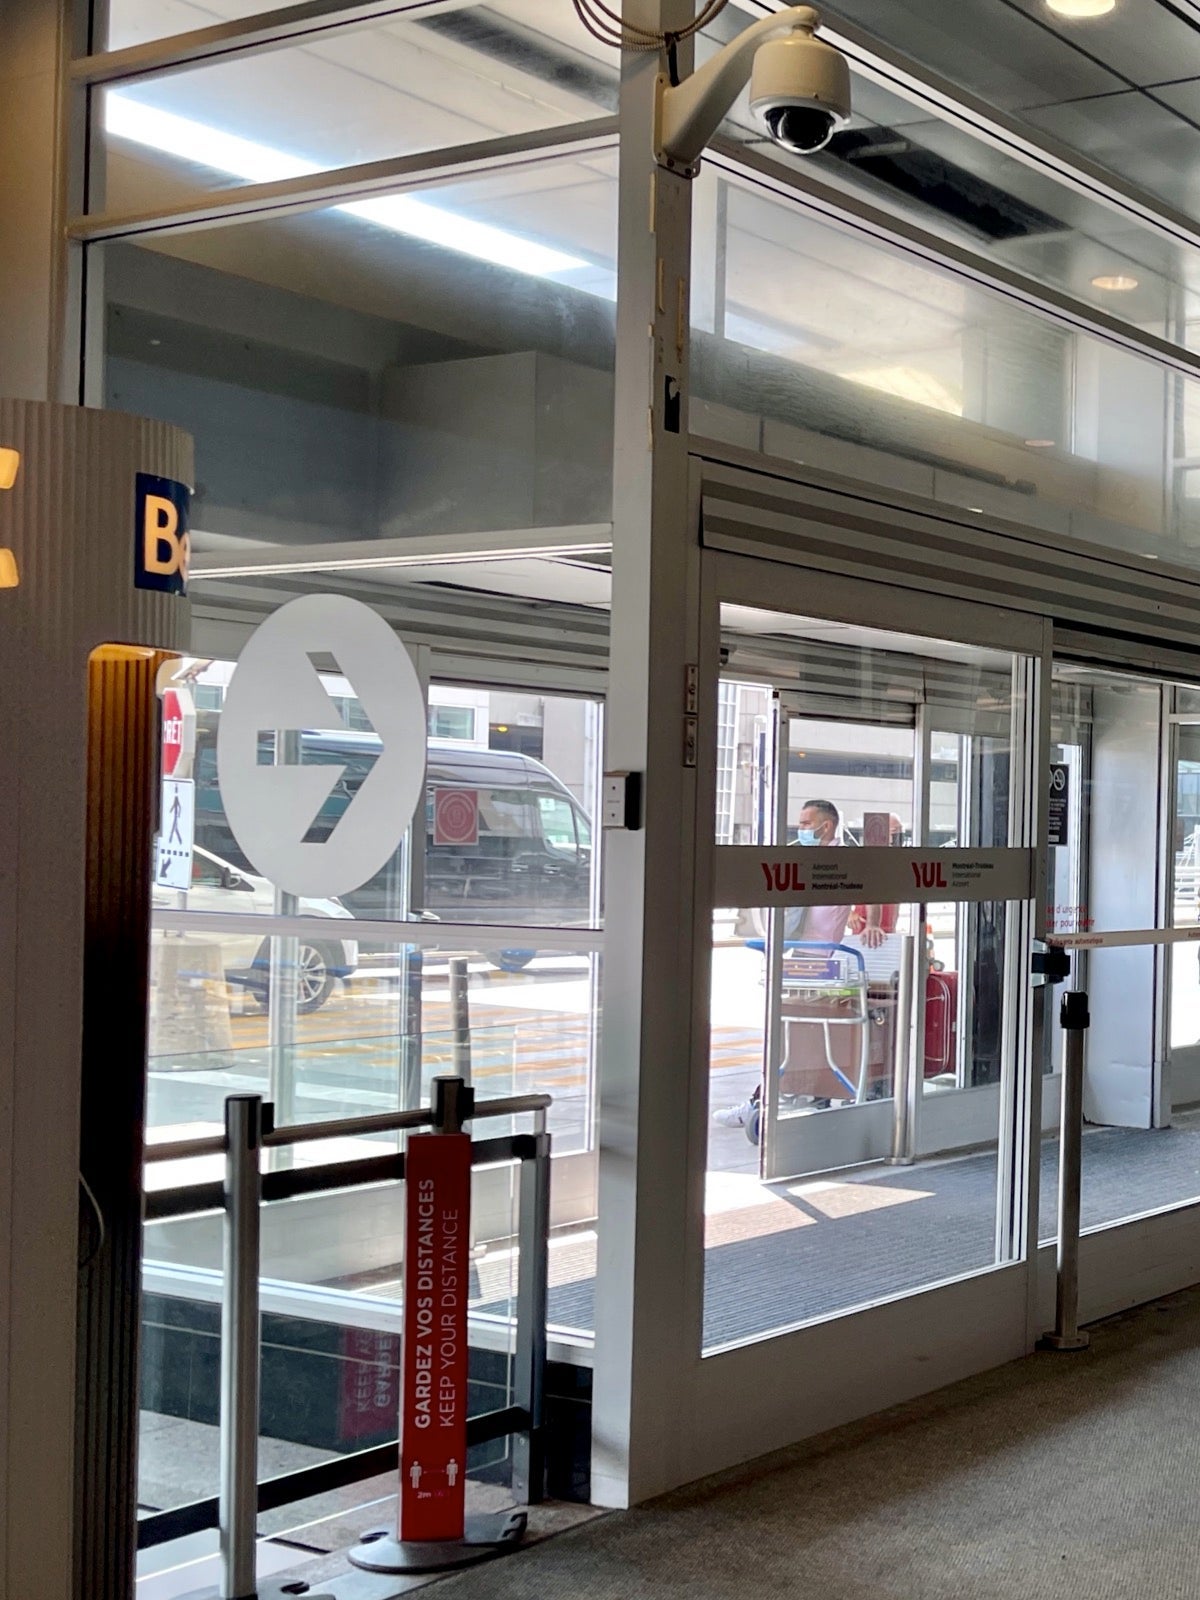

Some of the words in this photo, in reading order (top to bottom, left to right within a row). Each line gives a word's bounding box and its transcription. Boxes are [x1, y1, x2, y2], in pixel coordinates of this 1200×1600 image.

[761, 863, 805, 891] YUL
[912, 862, 947, 888] YUL
[417, 1178, 435, 1292] DISTANCES
[441, 1208, 458, 1308] DISTANCE
[416, 1297, 434, 1338] VOS
[440, 1313, 457, 1370] YOUR
[414, 1344, 433, 1429] GARDEZ
[439, 1376, 457, 1428] KEEP
